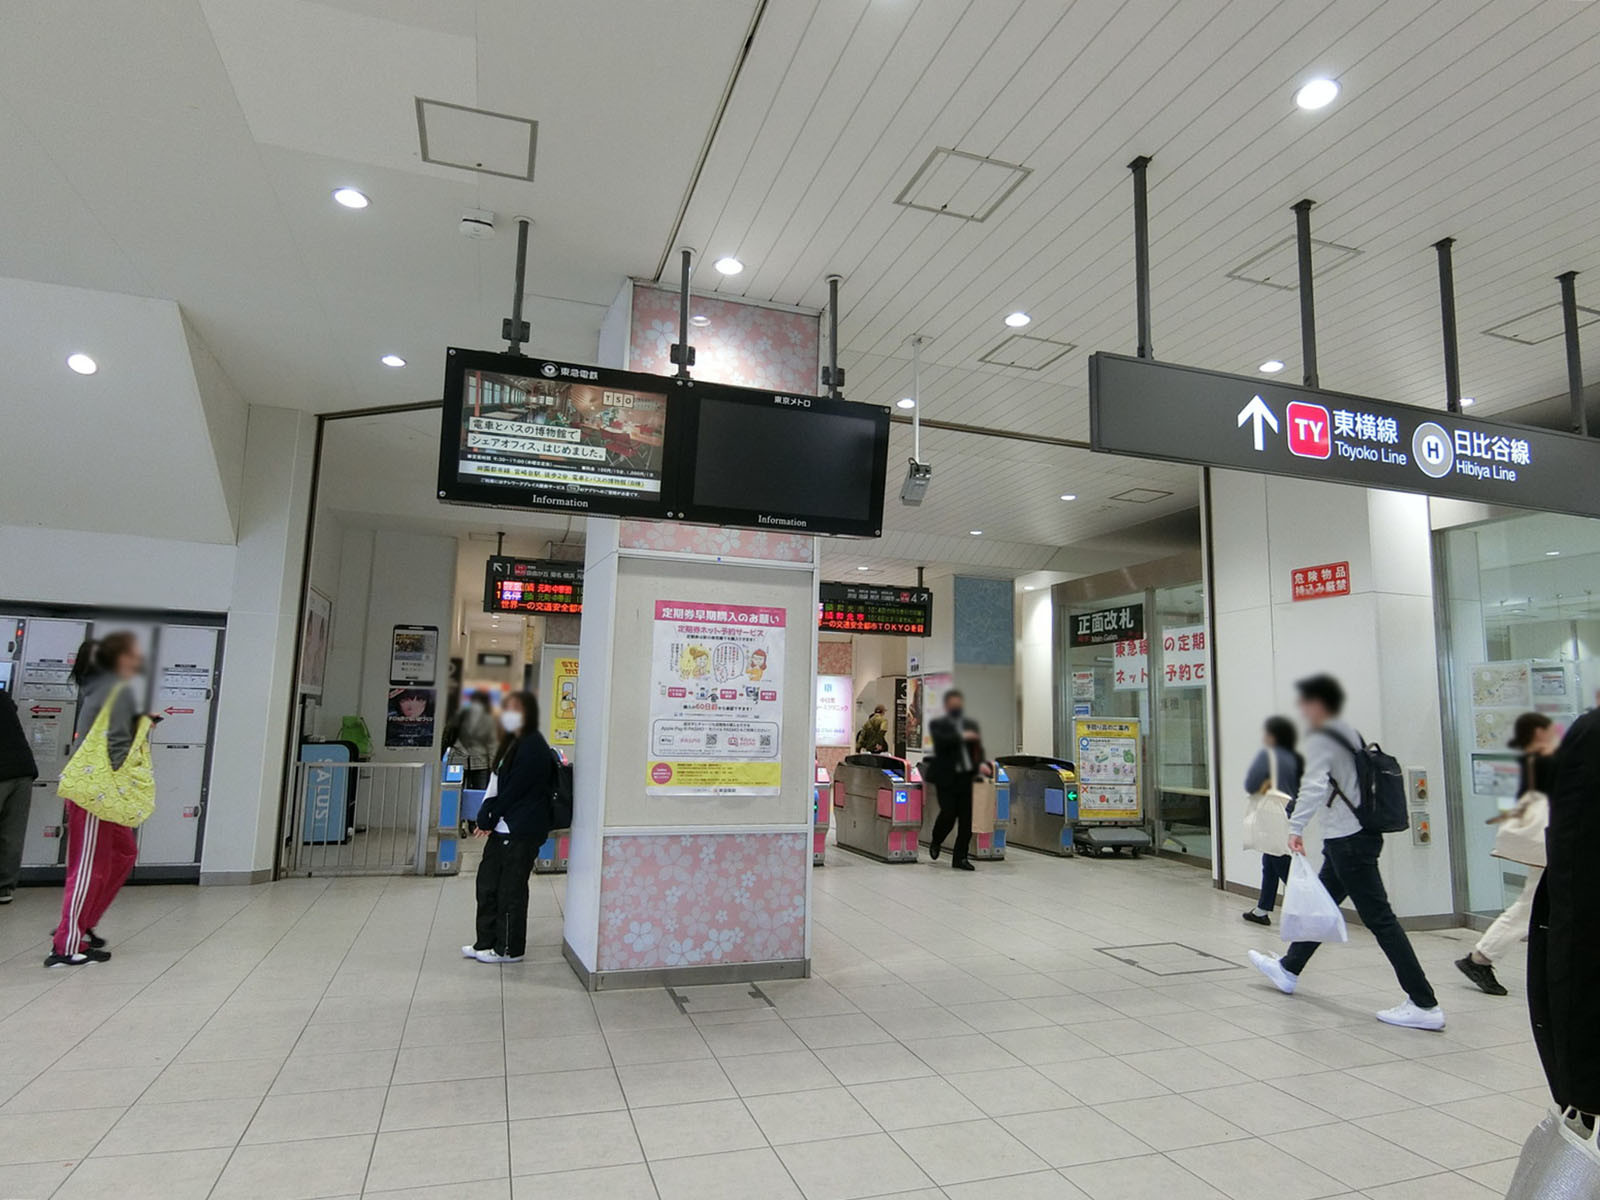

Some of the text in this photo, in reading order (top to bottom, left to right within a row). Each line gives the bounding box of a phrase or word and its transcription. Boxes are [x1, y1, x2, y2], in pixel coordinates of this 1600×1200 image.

[560, 366, 599, 380] 東急電鉄
[774, 395, 811, 408] 東京メトロ
[472, 419, 578, 441] 電車とバスの博物館で
[1294, 417, 1323, 443] TY
[1332, 409, 1399, 445] 東横線
[471, 435, 604, 459] シェアオフィス、はじめました。
[1381, 447, 1407, 466] Line
[1427, 440, 1439, 460] H
[1454, 429, 1531, 465] 日比谷線
[1455, 459, 1516, 482] Hibiya Line
[532, 494, 589, 508] Information
[758, 514, 807, 528] Information
[505, 563, 511, 575] 1
[1294, 565, 1346, 585] 危険物品
[910, 592, 918, 603] 4
[662, 606, 780, 625] 定期券早期購入のお願い
[1077, 607, 1135, 635] 正面改札
[677, 625, 766, 638] 定期券ネット予約サービス
[1164, 631, 1206, 652] の定期
[1116, 663, 1205, 684] ネット 予約で
